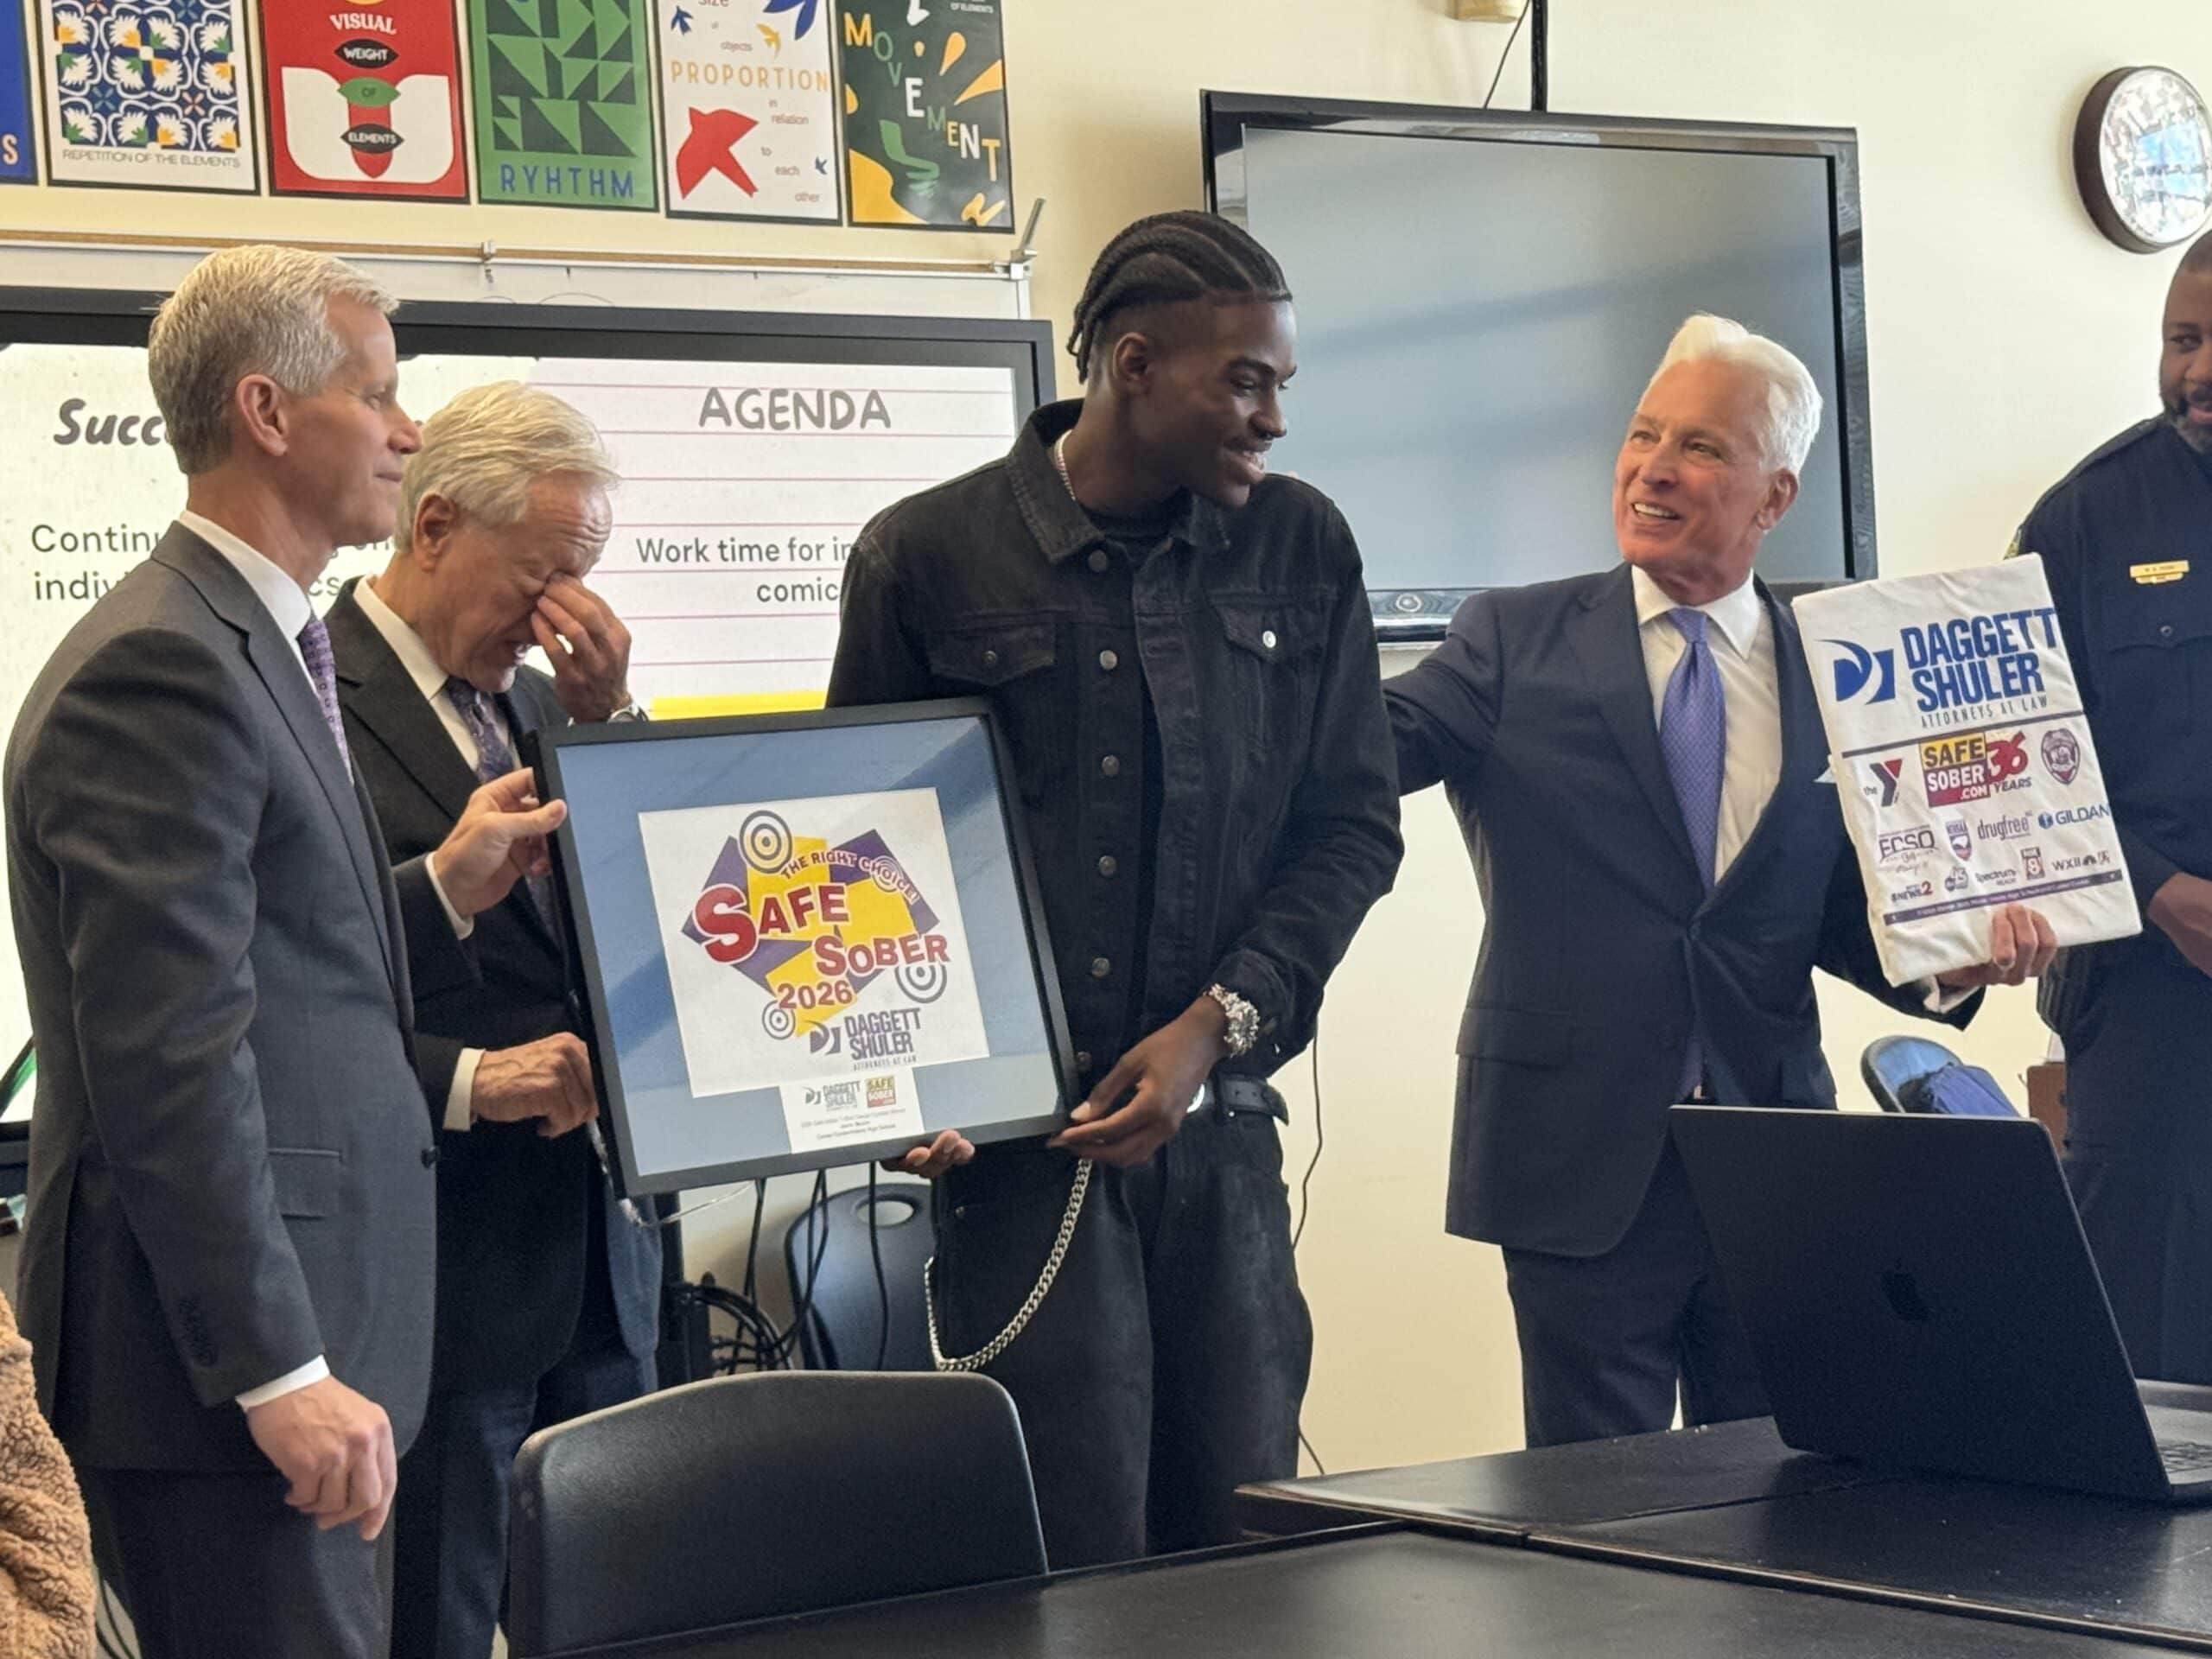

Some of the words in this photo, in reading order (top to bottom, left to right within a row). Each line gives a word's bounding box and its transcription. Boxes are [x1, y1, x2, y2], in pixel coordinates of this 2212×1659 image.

[329, 13, 397, 35] VISUAL
[344, 48, 388, 61] WEIGHT
[671, 60, 829, 92] PROPORTION
[361, 87, 377, 98] OF
[843, 11, 1001, 182] MOVEMENT
[771, 114, 809, 125] relation
[347, 132, 397, 144] ELEMENTS
[760, 146, 772, 156] to
[62, 149, 133, 163] REPETITION
[135, 152, 152, 164] OF
[156, 153, 178, 165] THE
[181, 156, 241, 168] ELEMENTS
[775, 165, 801, 175] each
[500, 163, 634, 200] RYHTHM
[795, 192, 821, 202] other
[53, 397, 168, 446] Succ
[699, 387, 891, 430] AGENDA
[32, 524, 160, 553] Contin
[636, 537, 710, 563] Work
[718, 537, 780, 562] time
[788, 537, 824, 562] for
[1900, 607, 2057, 670] DAGGETT
[1912, 652, 2046, 712] SHULER
[1921, 703, 1994, 728] ATTORNEYS
[2001, 701, 2014, 715] AT
[2021, 695, 2048, 713] LAW
[1924, 737, 1985, 768] SAFE
[1863, 785, 1878, 796] the
[1928, 765, 1986, 792] SOBER
[1994, 776, 2031, 793] YEARS
[2056, 804, 2109, 824] GILDAN
[1977, 815, 2031, 841] drugfree
[780, 856, 809, 880] THE
[811, 851, 858, 866] RIGHT
[695, 885, 849, 963] SAFE
[814, 935, 950, 976] SOBER
[778, 980, 853, 1009] 2026
[844, 1007, 921, 1037] DAGGETT
[849, 1032, 914, 1060] SHULER
[867, 1077, 893, 1091] SAFE
